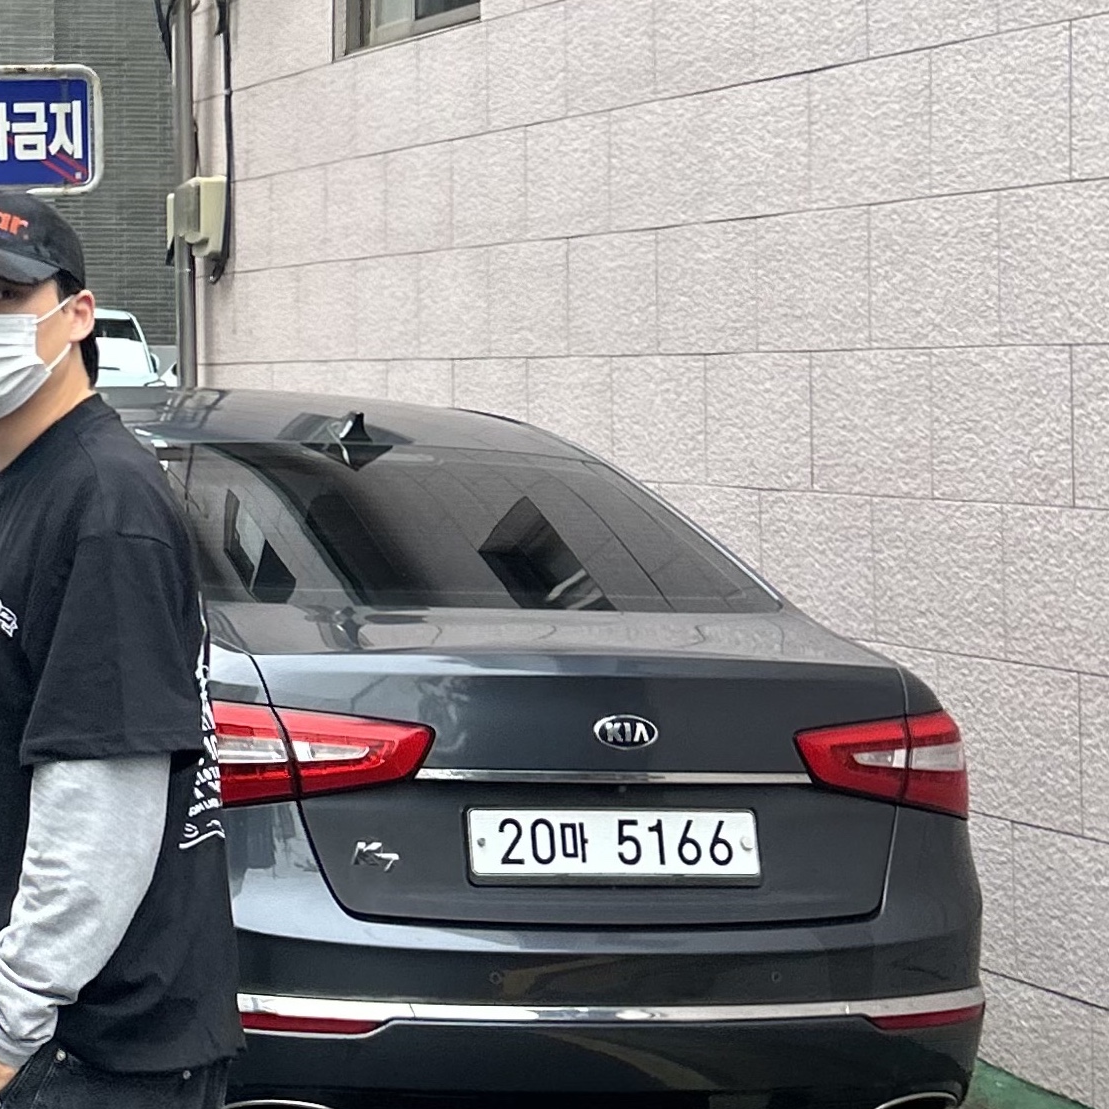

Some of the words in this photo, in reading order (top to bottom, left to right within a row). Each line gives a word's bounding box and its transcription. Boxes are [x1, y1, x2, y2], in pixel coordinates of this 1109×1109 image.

[605, 721, 649, 742] KIA
[351, 841, 400, 872] K7
[498, 817, 589, 865] 20마
[617, 818, 734, 866] 5166
